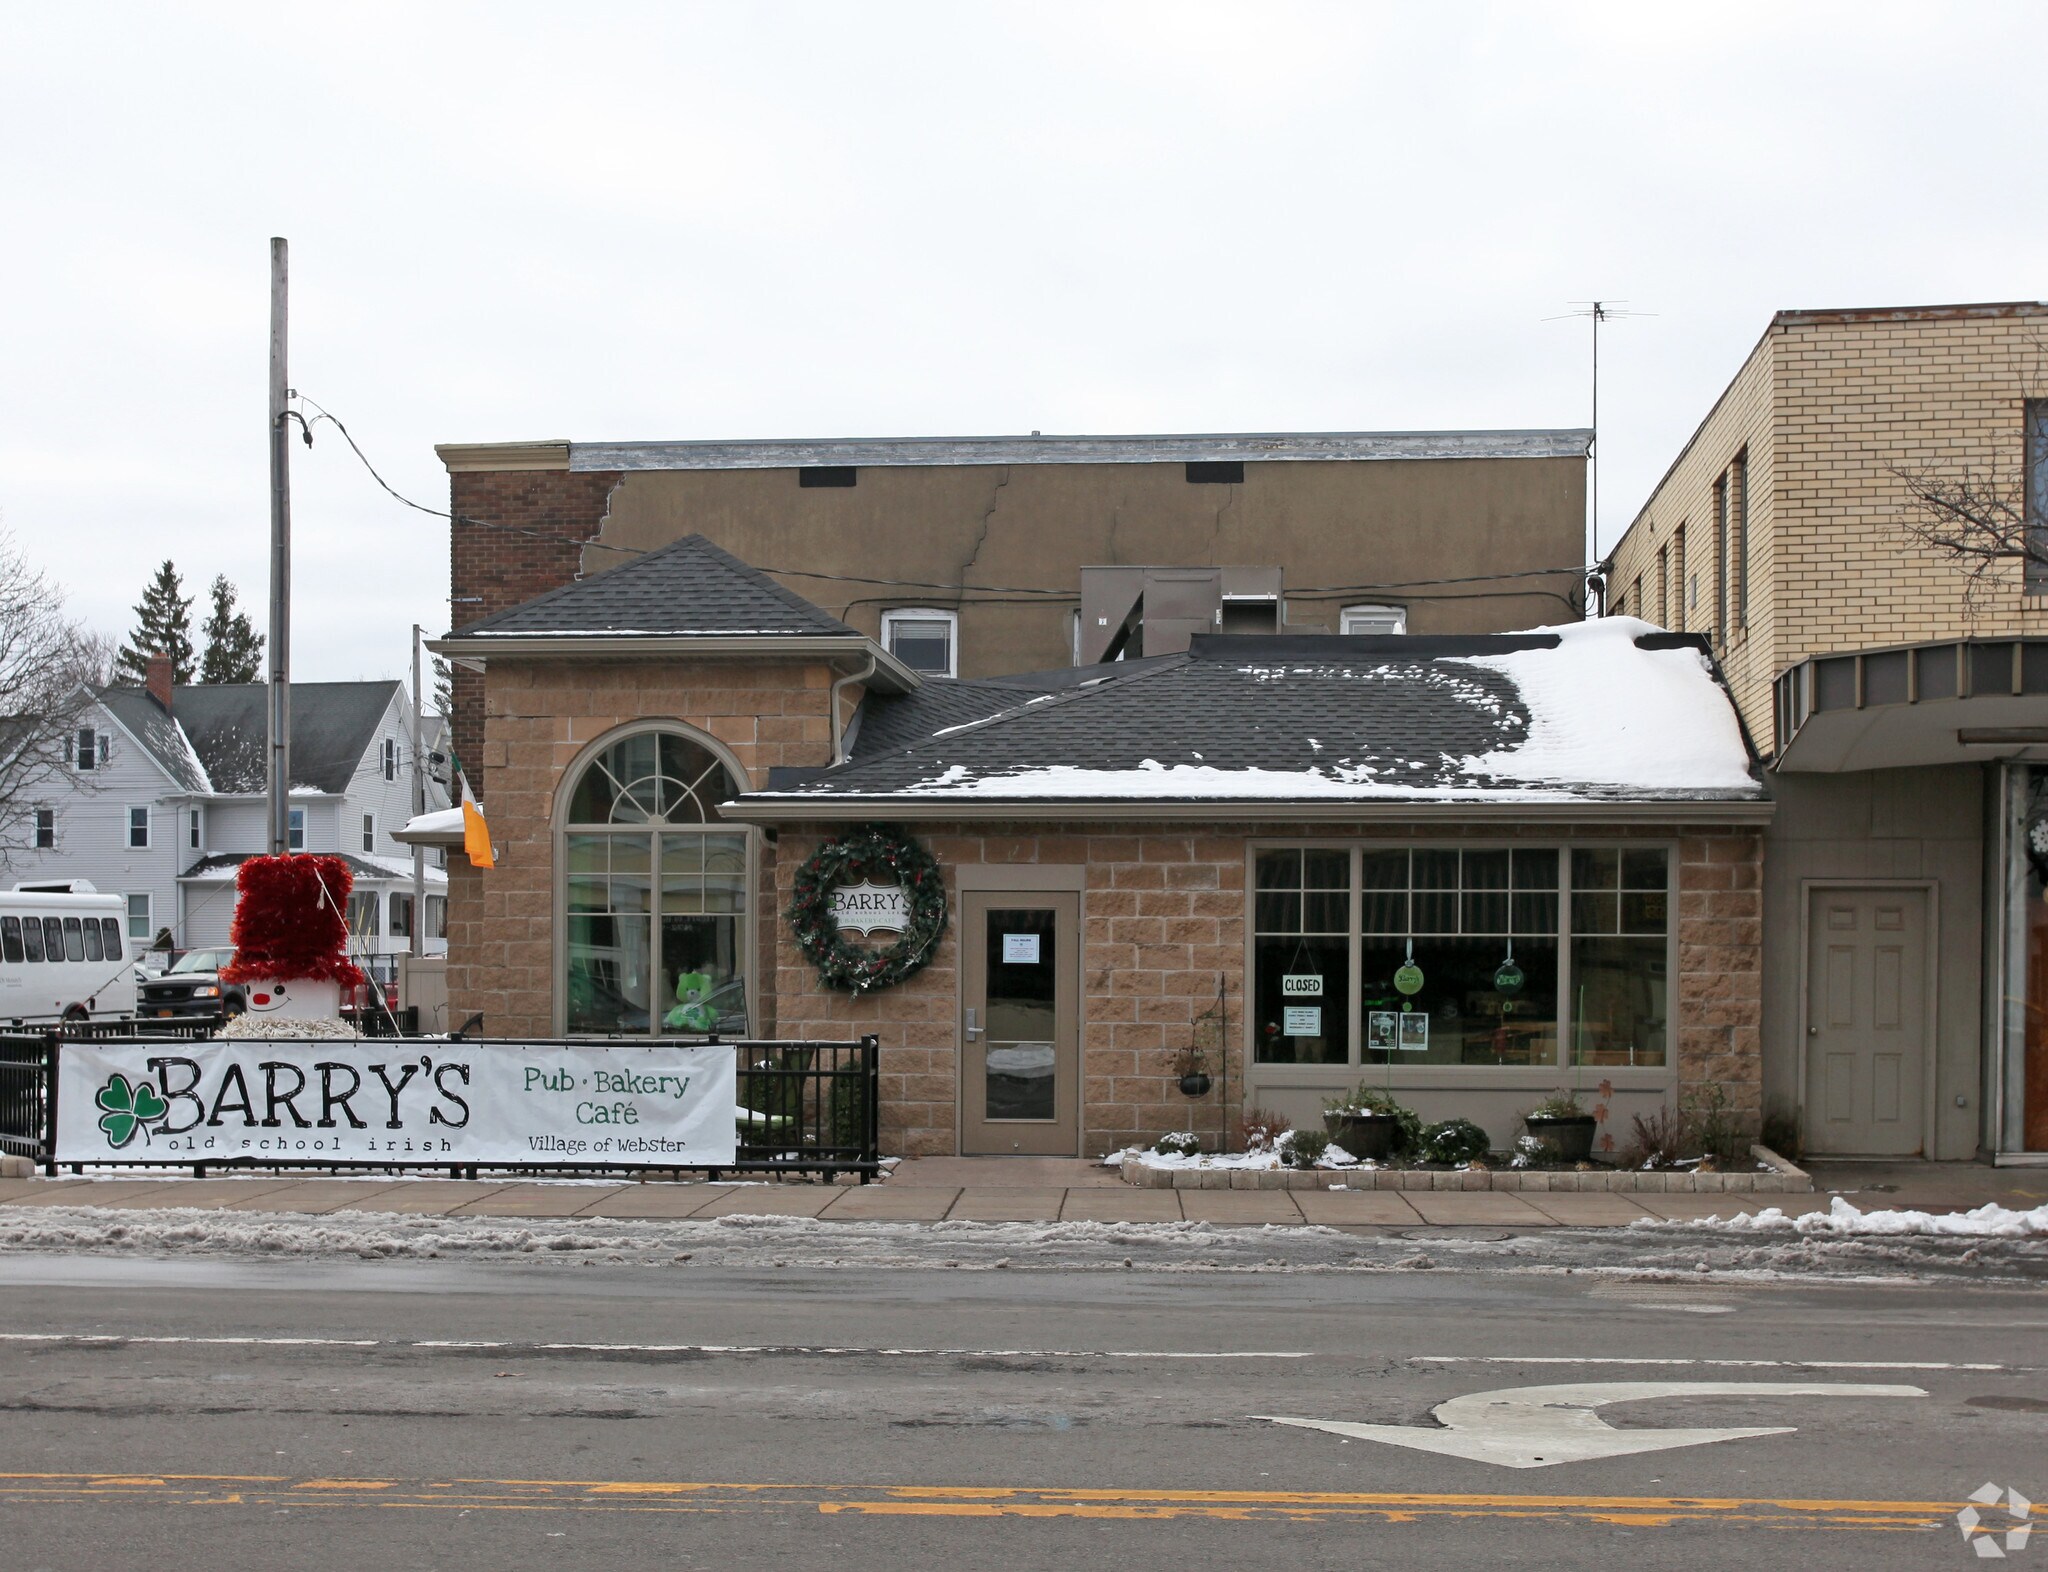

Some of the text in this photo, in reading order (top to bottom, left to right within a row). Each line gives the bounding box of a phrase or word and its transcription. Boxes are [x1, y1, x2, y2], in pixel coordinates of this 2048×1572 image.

[832, 892, 911, 911] BARRYS
[1285, 979, 1321, 992] CLOSED
[524, 1067, 691, 1099] Pub Bakery
[146, 1055, 471, 1136] BARRY'S
[575, 1101, 640, 1125] Café
[169, 1136, 453, 1152] old school irish
[528, 1135, 588, 1155] Village
[593, 1137, 613, 1153] of
